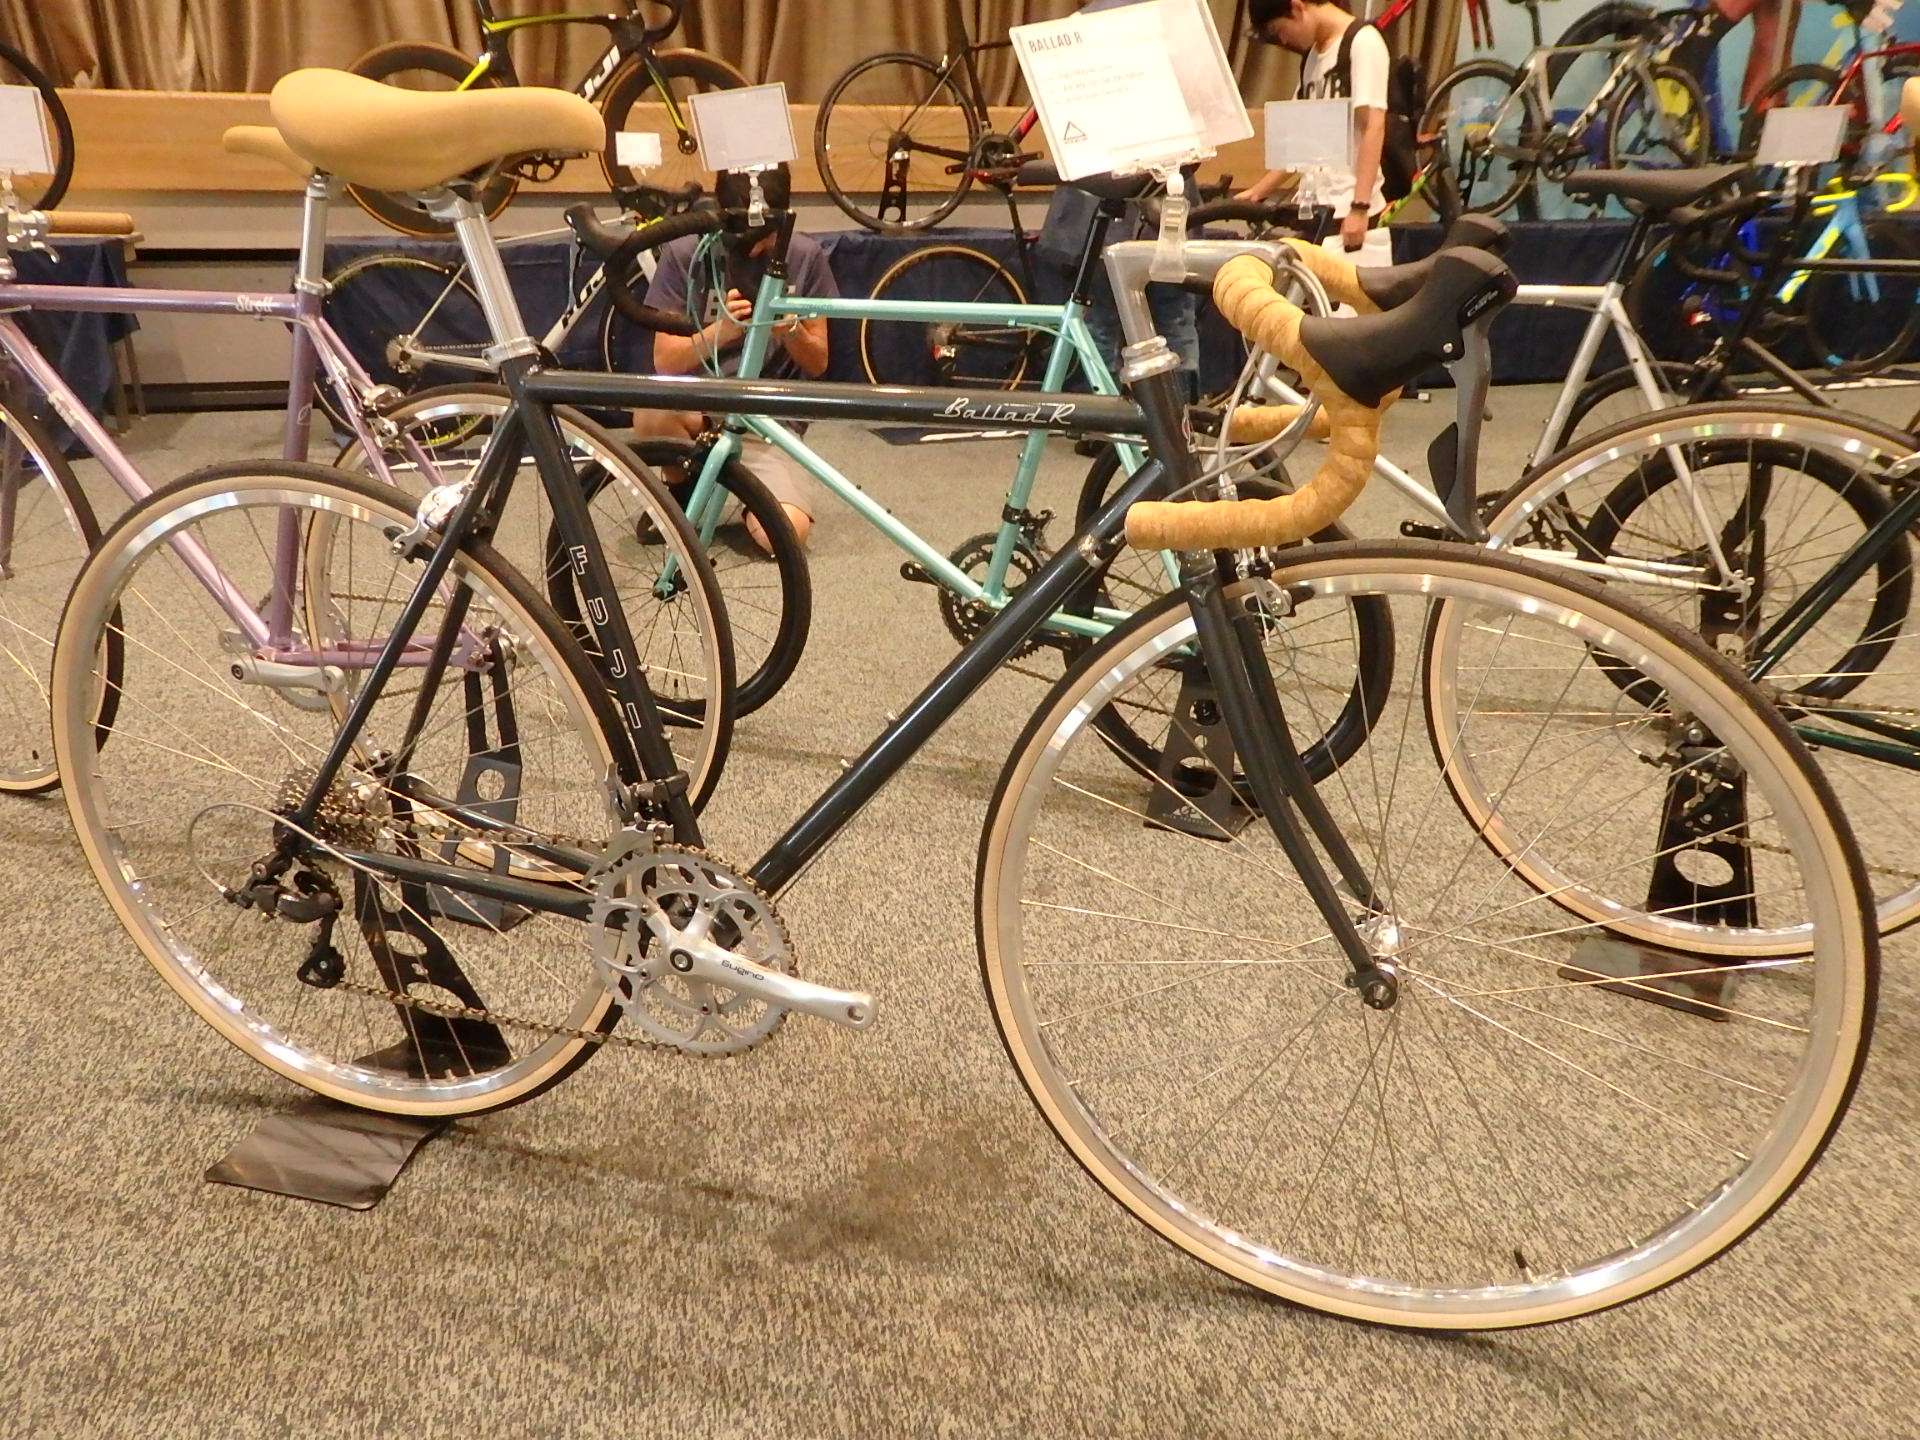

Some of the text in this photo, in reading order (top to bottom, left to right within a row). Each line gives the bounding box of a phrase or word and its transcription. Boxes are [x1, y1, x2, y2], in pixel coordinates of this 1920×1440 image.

[1028, 31, 1084, 53] BALLAD R
[933, 397, 1047, 424] Ballad
[569, 545, 641, 729] FUJI
